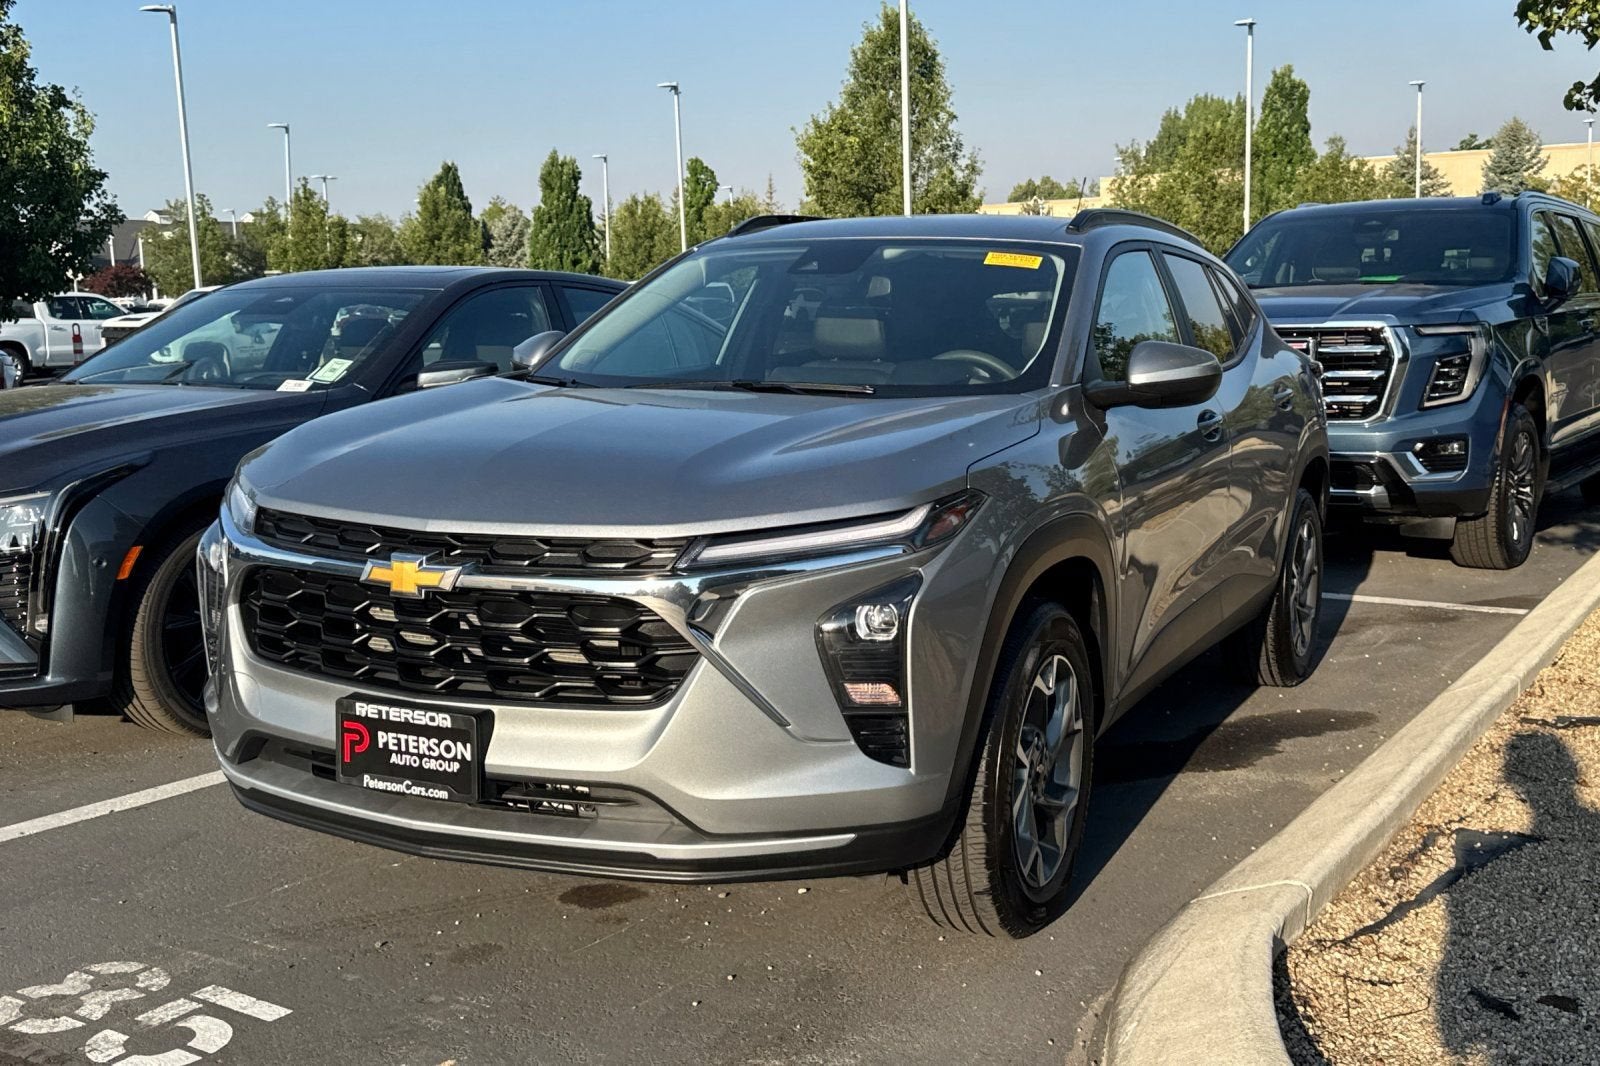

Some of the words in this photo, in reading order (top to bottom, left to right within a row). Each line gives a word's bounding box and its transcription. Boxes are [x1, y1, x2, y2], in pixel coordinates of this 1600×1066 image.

[377, 731, 472, 761] PETERSON
[390, 753, 420, 767] AUTO
[422, 759, 460, 772] GROUP
[363, 774, 449, 798] PetersonCars.com
